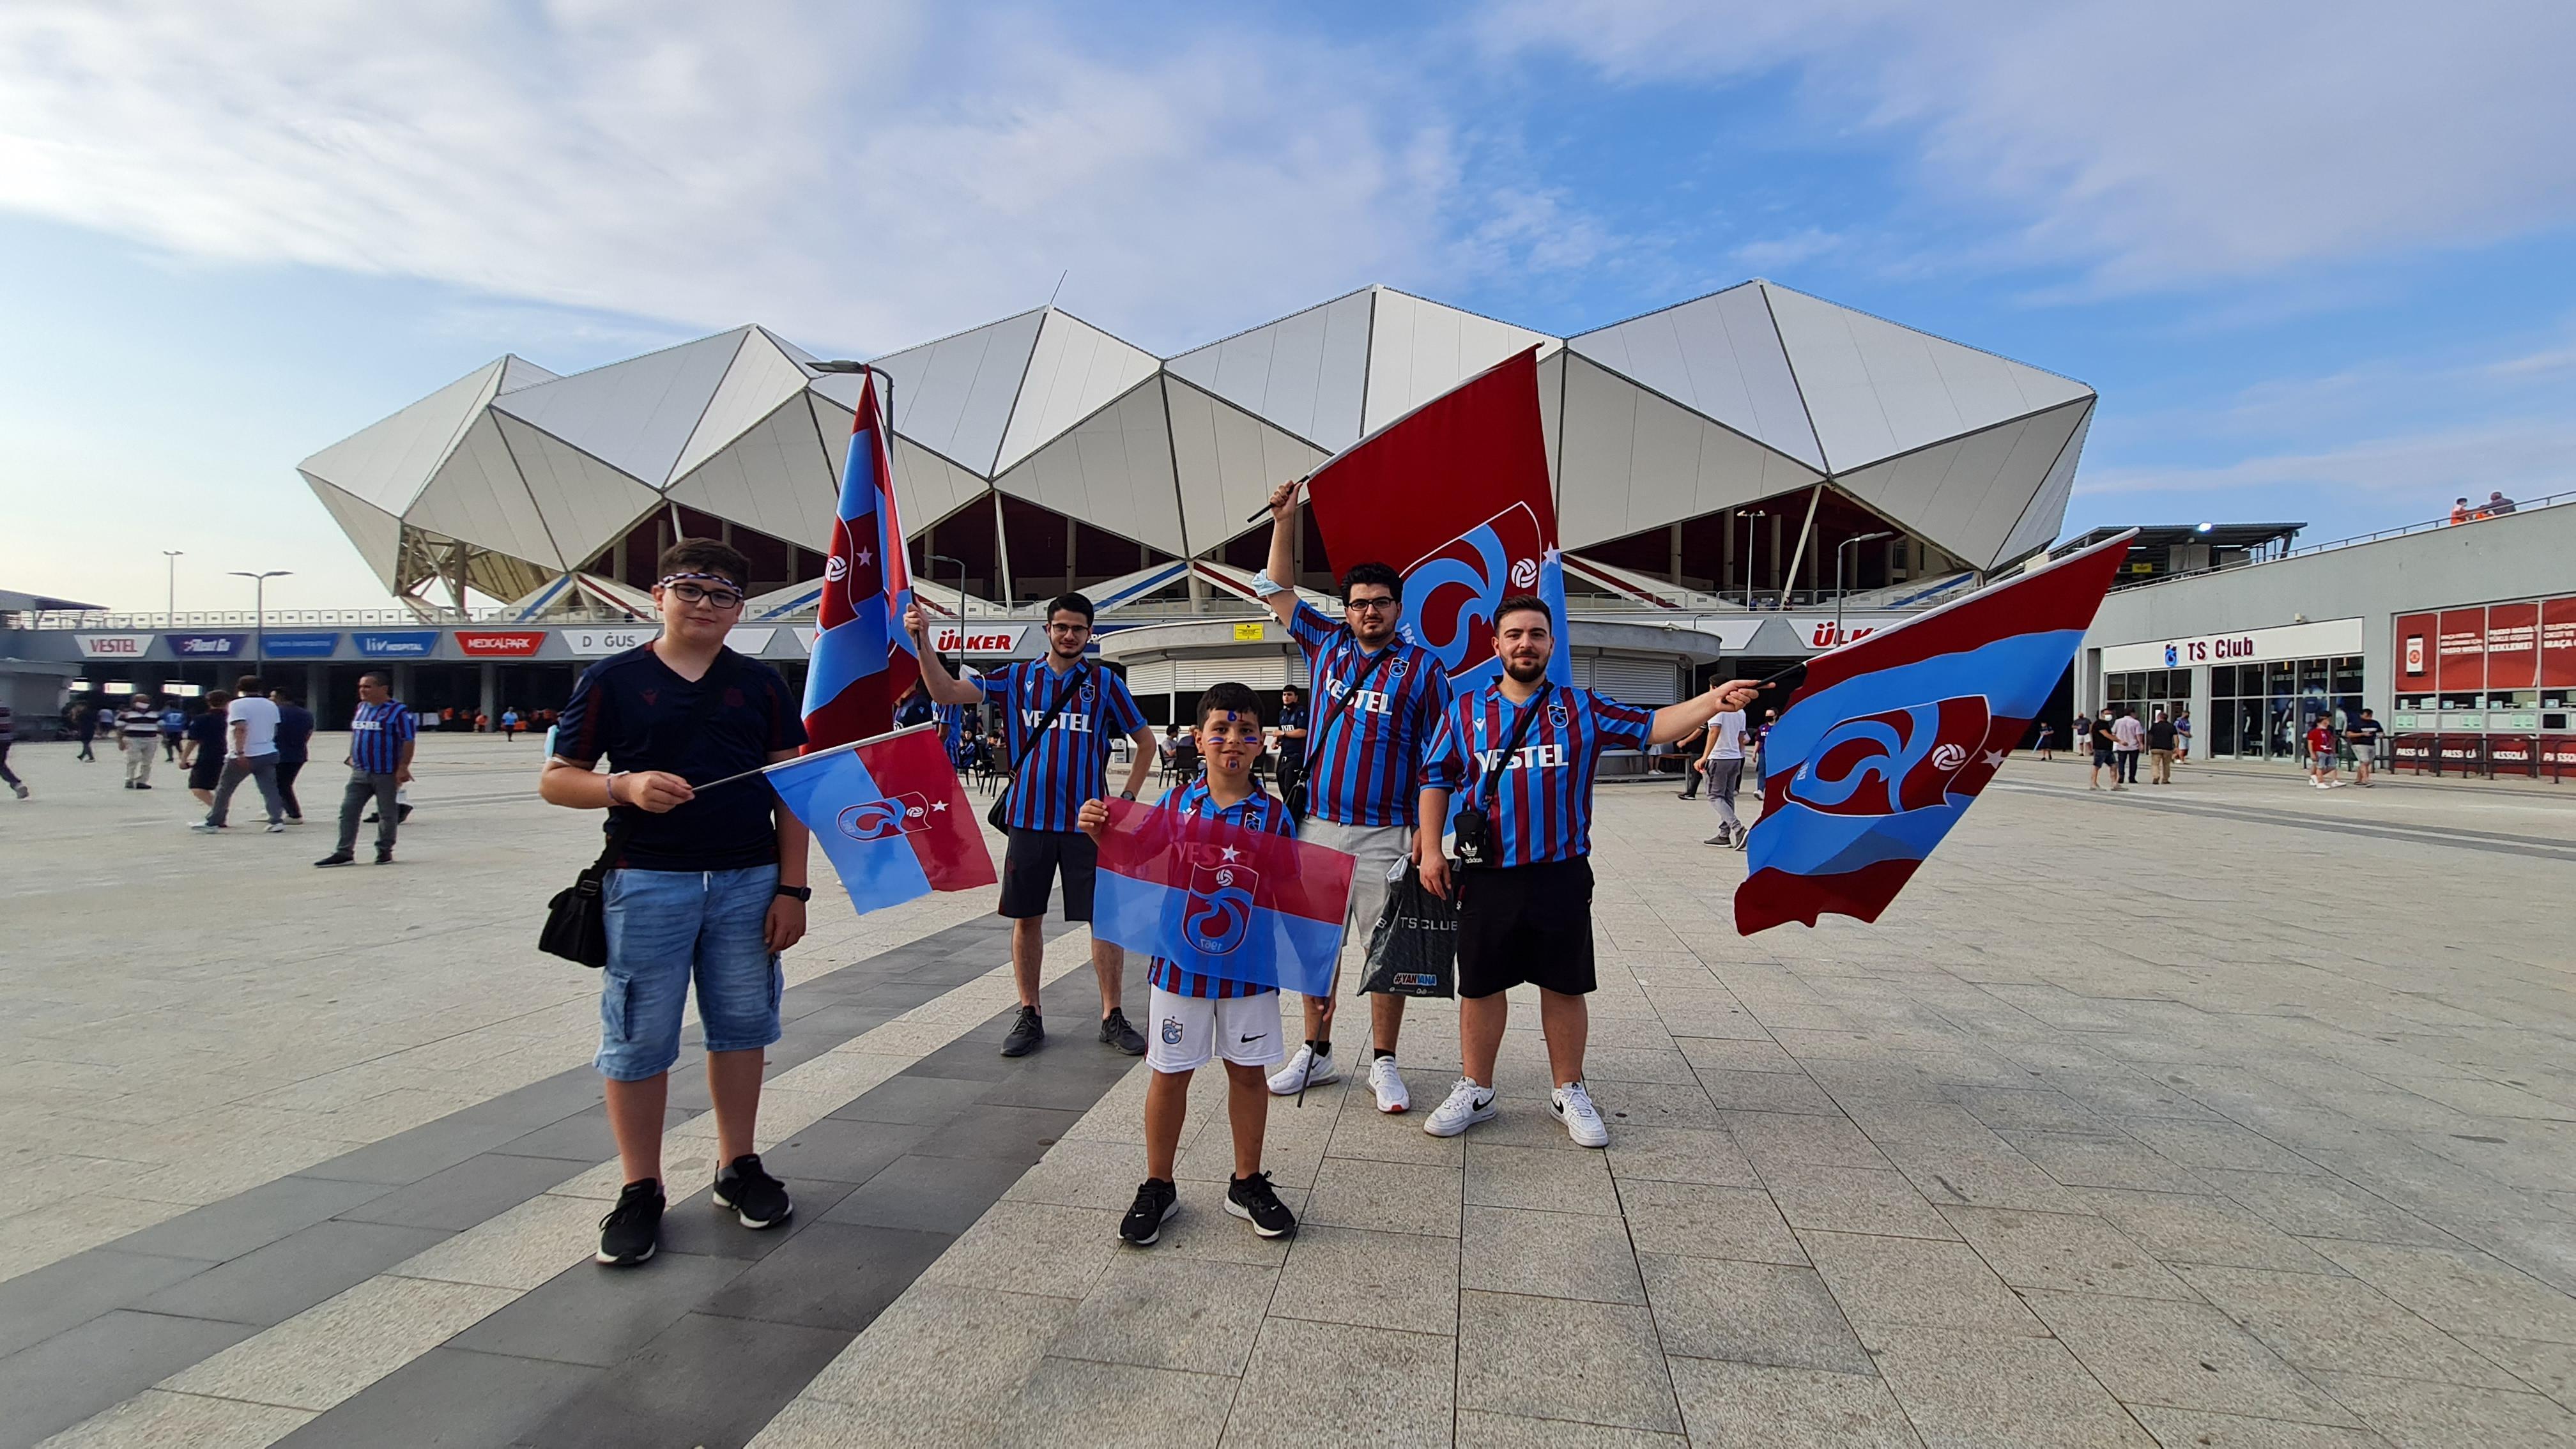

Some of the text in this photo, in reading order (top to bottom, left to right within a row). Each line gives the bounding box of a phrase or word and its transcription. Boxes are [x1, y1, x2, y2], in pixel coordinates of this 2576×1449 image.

[938, 629, 1011, 650] ÜLKER
[1813, 621, 1874, 647] ÜLK
[89, 639, 137, 652] VESTEL
[2188, 637, 2253, 661] TS Club
[352, 721, 383, 730] ESTEL
[1400, 917, 1418, 929] TS
